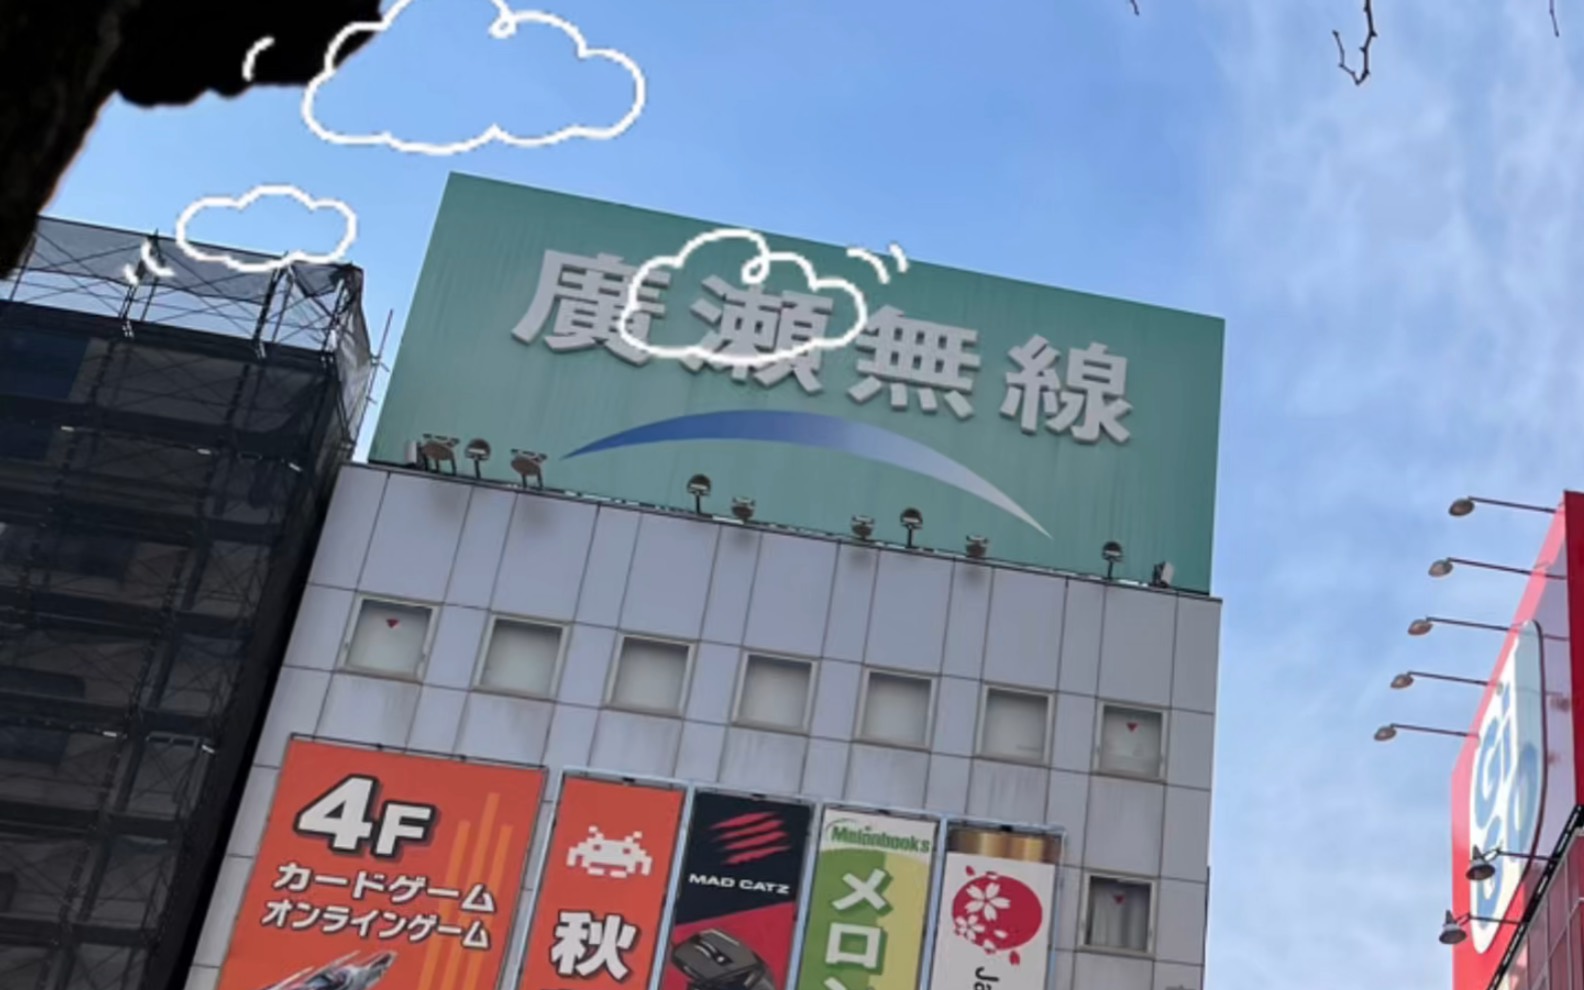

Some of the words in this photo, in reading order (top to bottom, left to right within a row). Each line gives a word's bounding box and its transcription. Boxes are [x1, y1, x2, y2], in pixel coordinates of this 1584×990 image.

[298, 776, 435, 856] 4F
[831, 824, 931, 854] Melonbooks
[273, 862, 497, 912] カードゲーム
[689, 873, 735, 889] MAD
[739, 879, 790, 895] CATZ
[261, 900, 490, 949] オンラインゲーム
